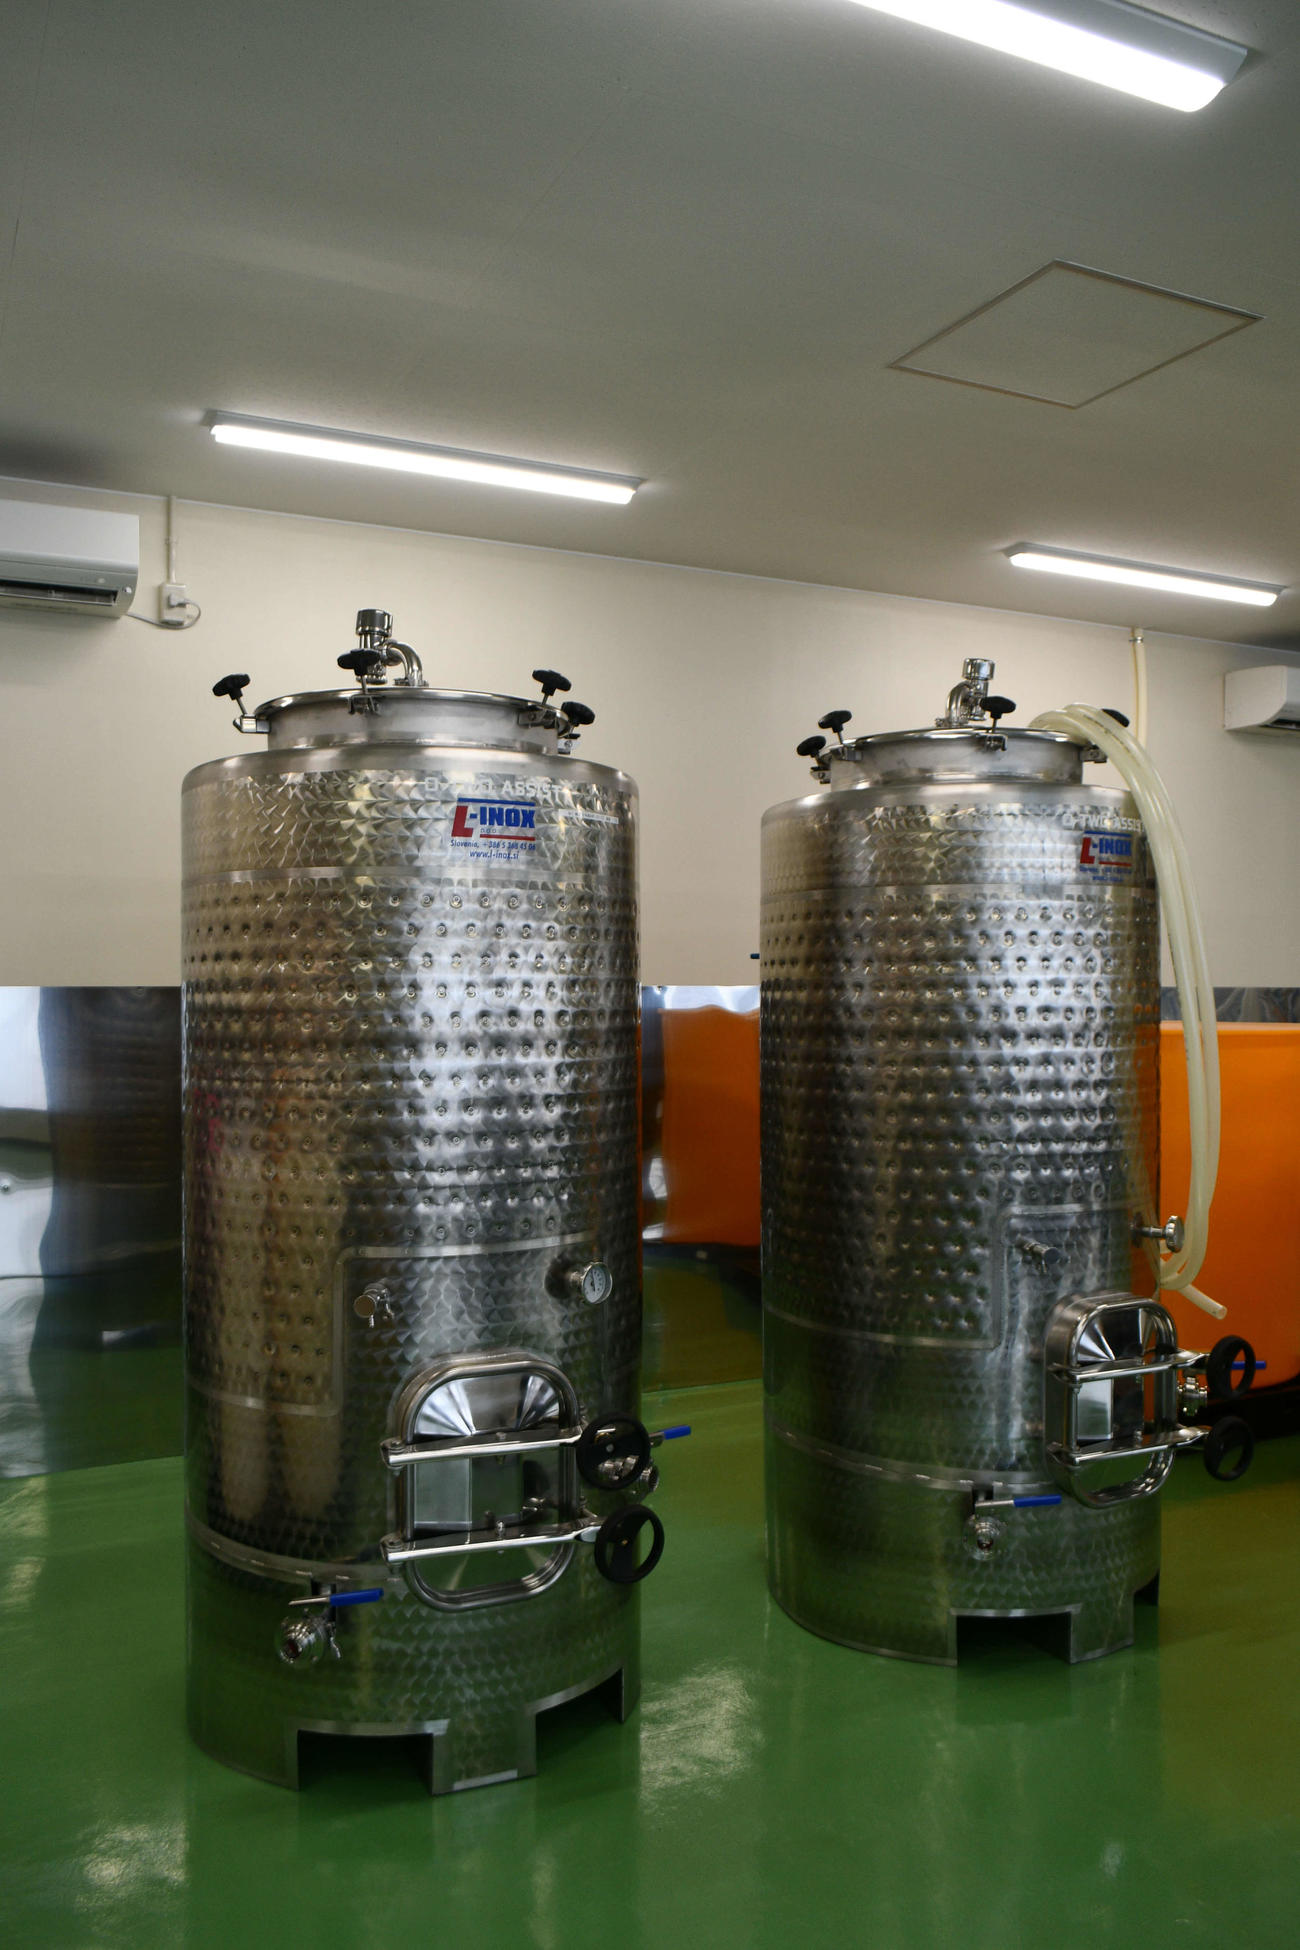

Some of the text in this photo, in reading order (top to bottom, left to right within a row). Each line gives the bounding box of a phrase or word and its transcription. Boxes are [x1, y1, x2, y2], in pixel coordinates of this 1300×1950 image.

[501, 780, 562, 801] ASSIST
[451, 805, 535, 838] L-INOX
[450, 840, 479, 849] Slovenia,
[469, 849, 519, 860] www.l-inox.si
